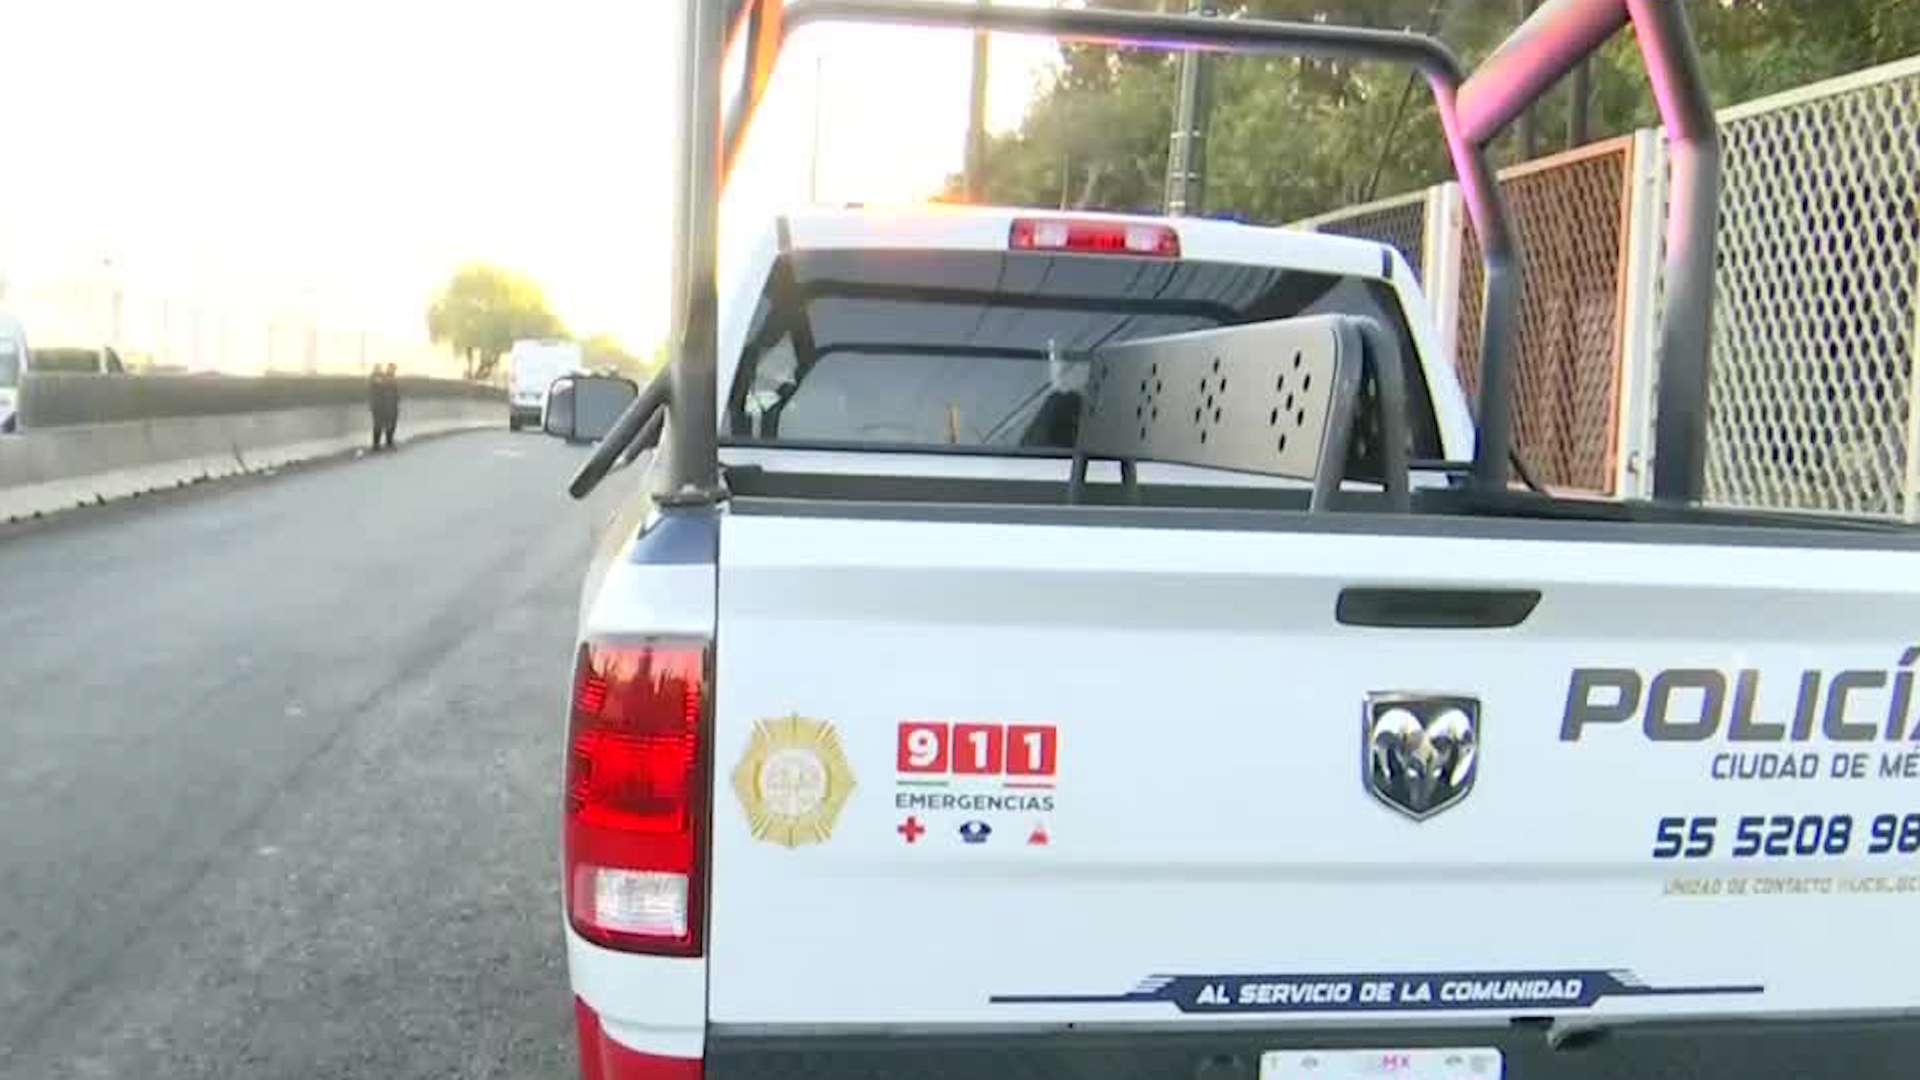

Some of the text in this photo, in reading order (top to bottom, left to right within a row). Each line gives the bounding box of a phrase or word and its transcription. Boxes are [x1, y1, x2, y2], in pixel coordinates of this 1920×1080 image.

[1559, 646, 1920, 742] POLICÍ
[905, 728, 1043, 771] 911
[1711, 752, 1819, 779] CIUDAD
[1830, 752, 1869, 778] DE
[895, 793, 1054, 811] EMERGENCIAS
[1653, 813, 1920, 858] 55 5208 98
[1196, 978, 1583, 1005] AL SERVICIO DE LA COMUNIDAD
